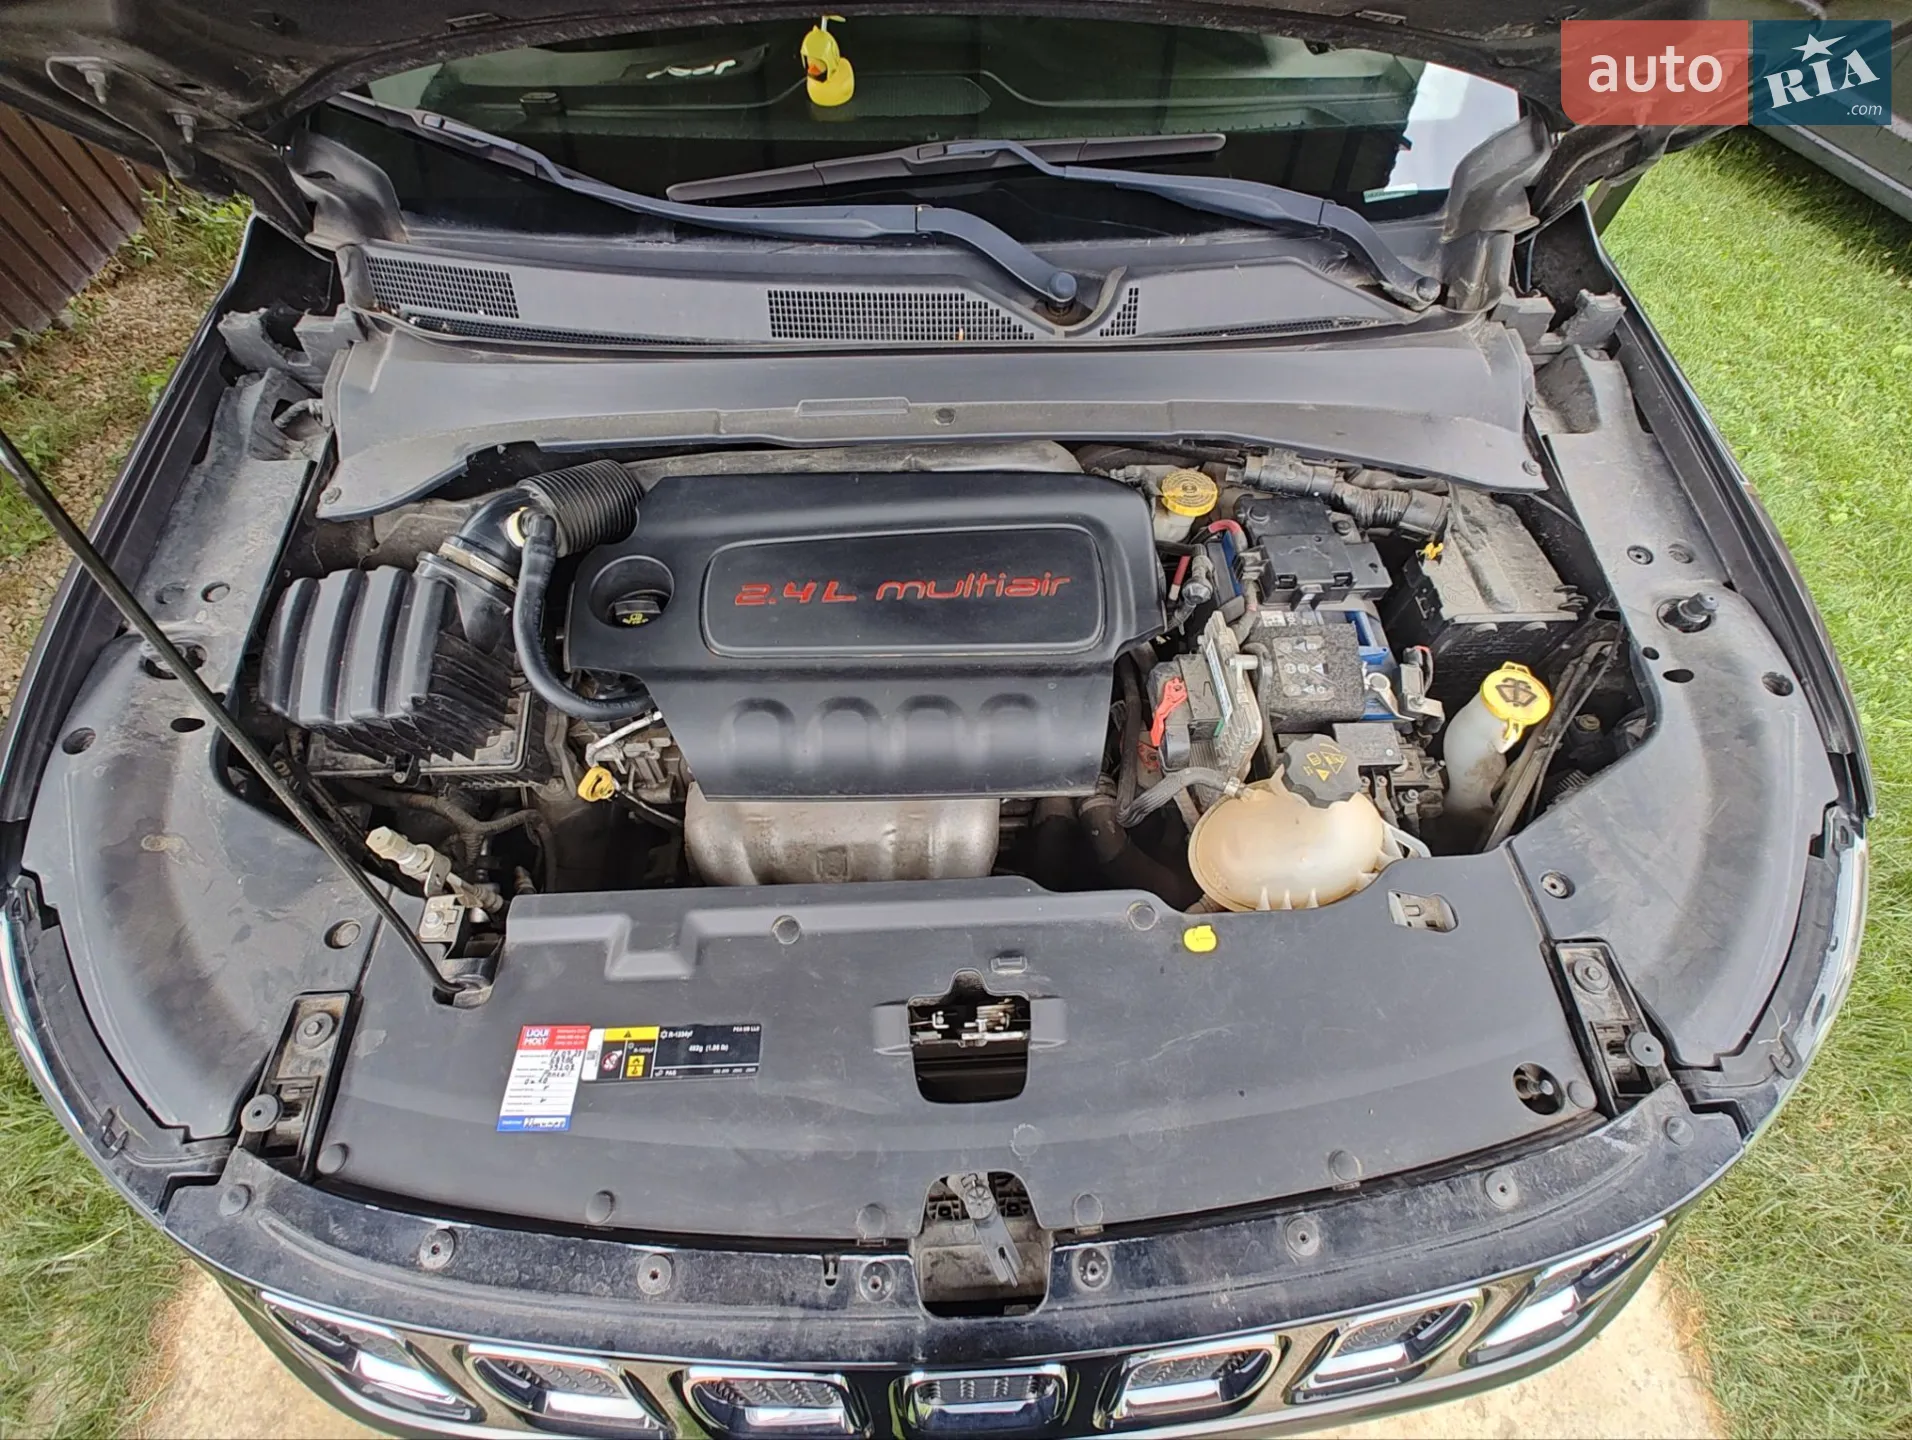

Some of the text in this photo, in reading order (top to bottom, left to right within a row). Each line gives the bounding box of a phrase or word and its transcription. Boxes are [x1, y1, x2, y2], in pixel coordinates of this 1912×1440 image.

[876, 572, 1071, 600] multiair
[526, 1029, 550, 1038] LIQUI
[523, 1038, 548, 1046] MOLY
